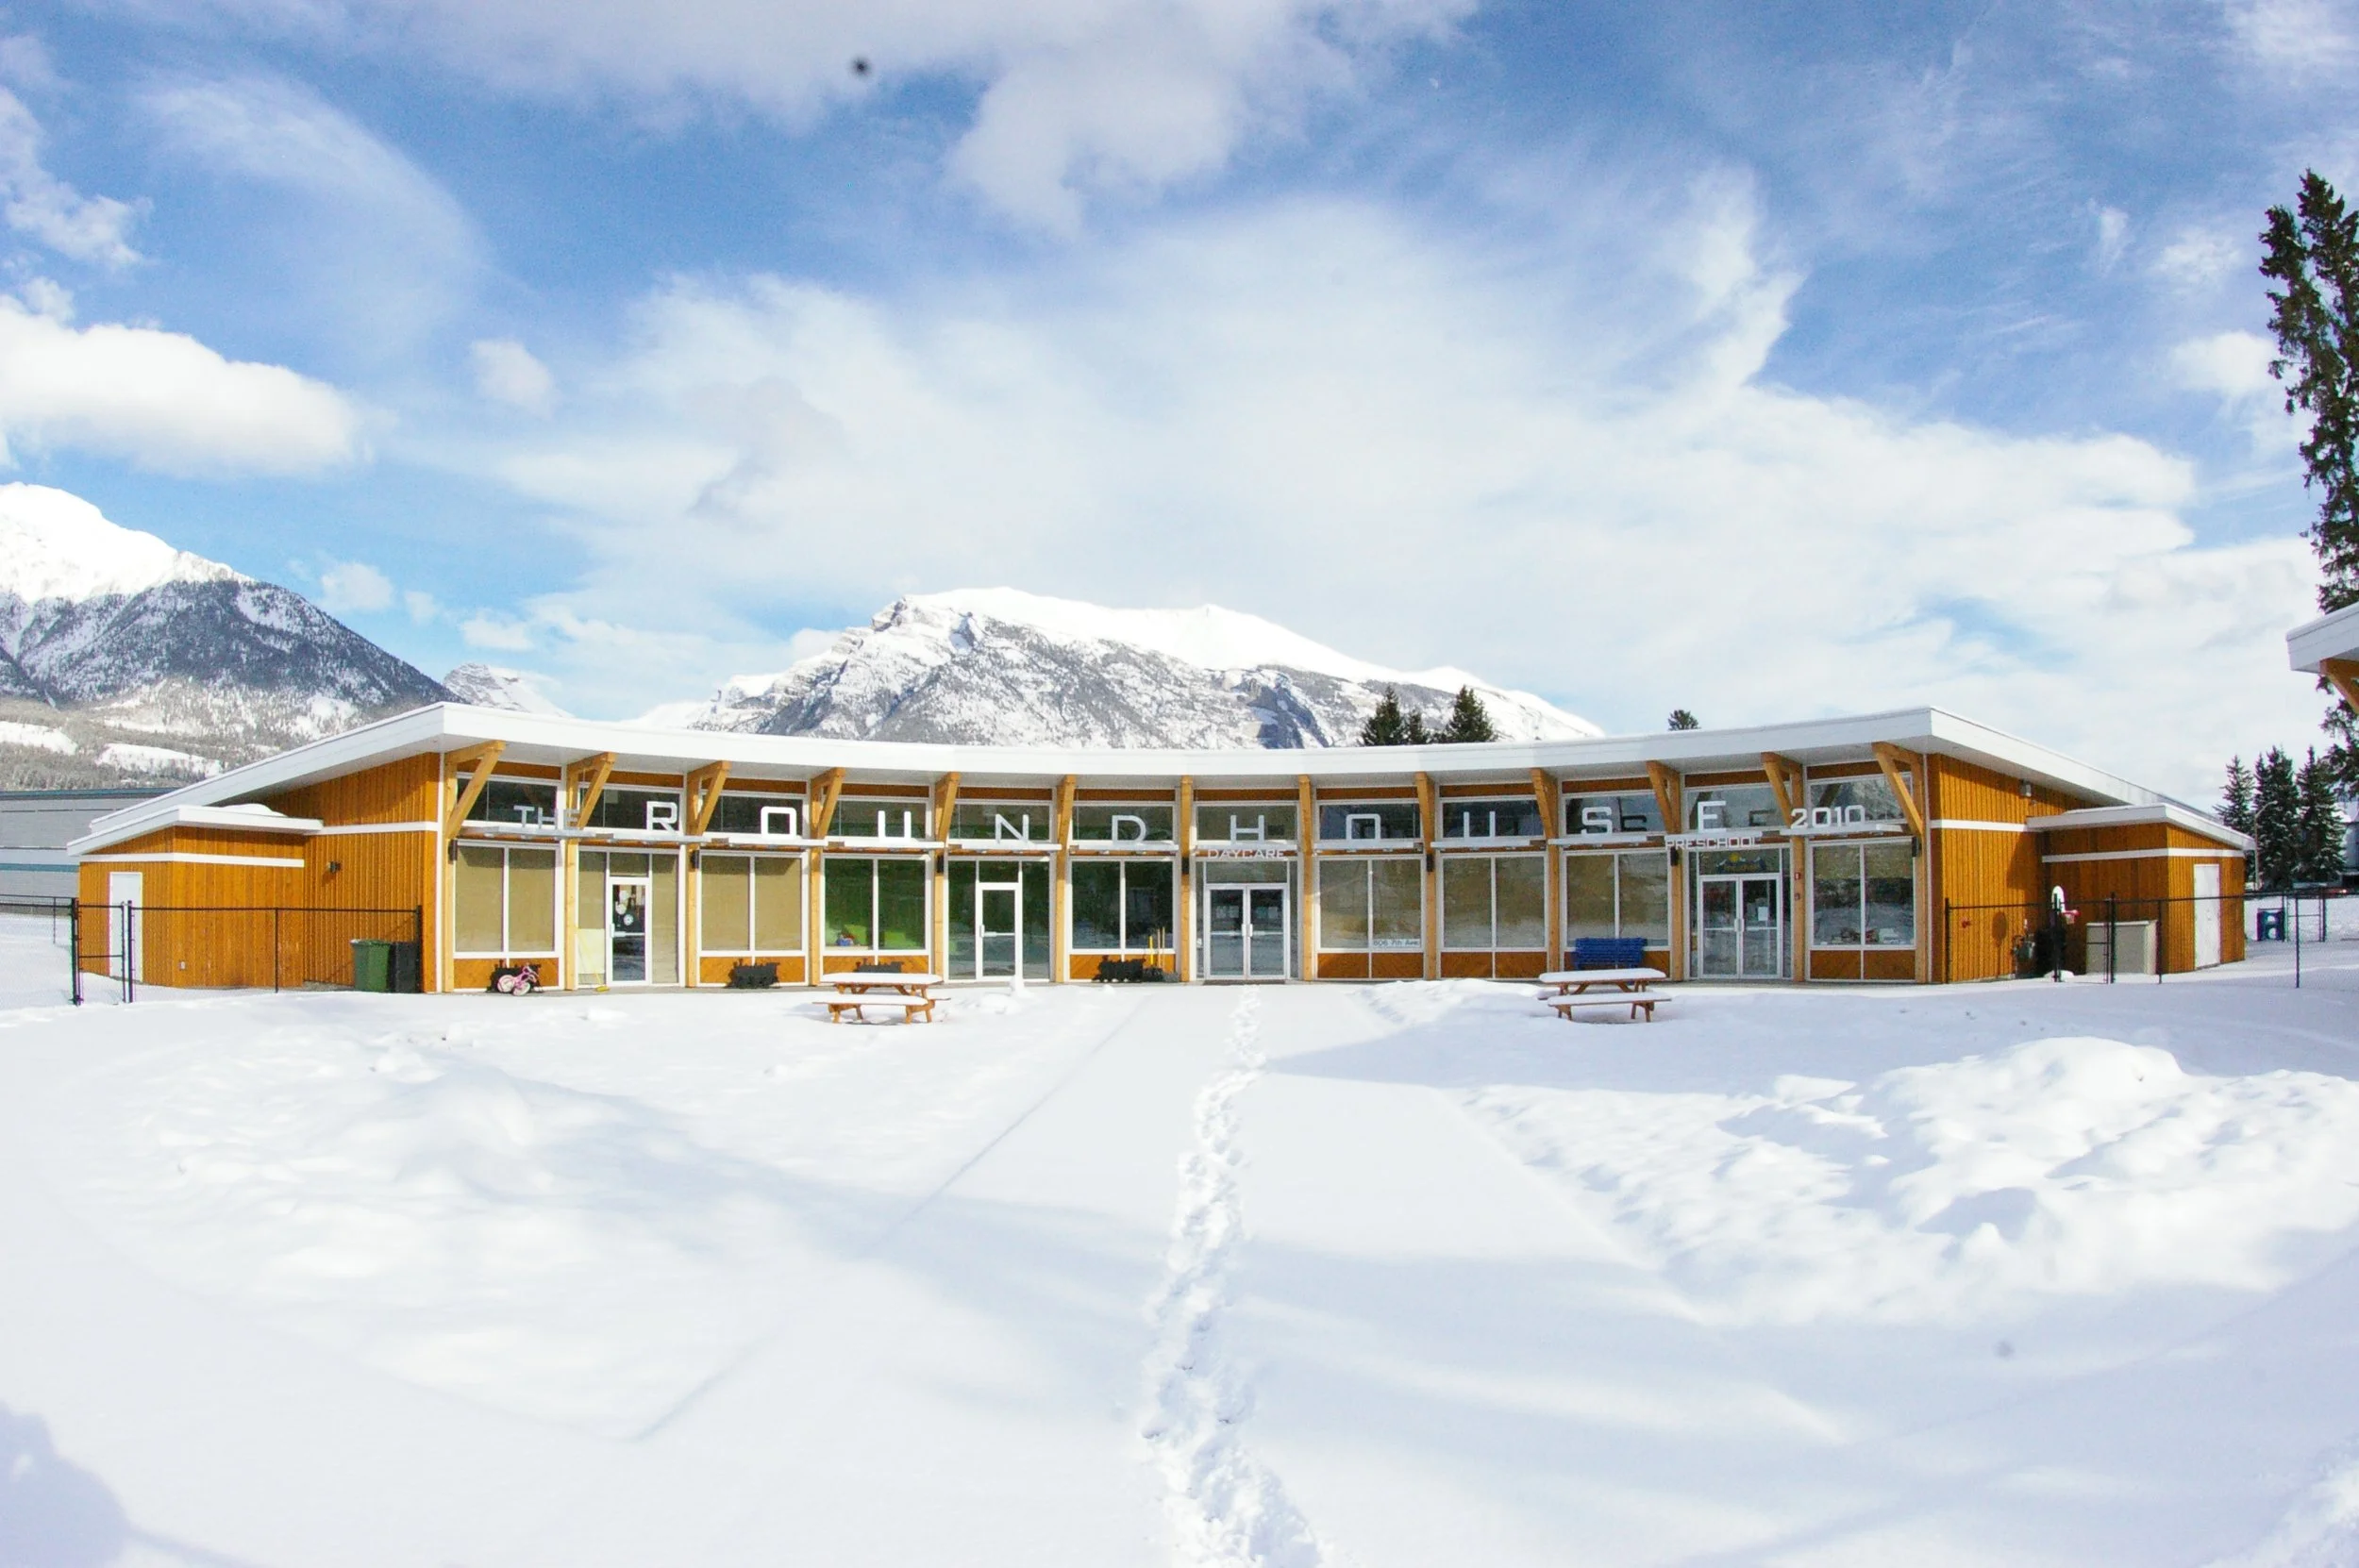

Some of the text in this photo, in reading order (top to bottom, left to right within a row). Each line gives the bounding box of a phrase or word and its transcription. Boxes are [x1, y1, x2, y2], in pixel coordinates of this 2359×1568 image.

[513, 800, 1865, 845] THE ROUND HOUSE 2010
[1665, 837, 1759, 849] PRESCHOOL
[1208, 849, 1284, 859] DAYCARE
